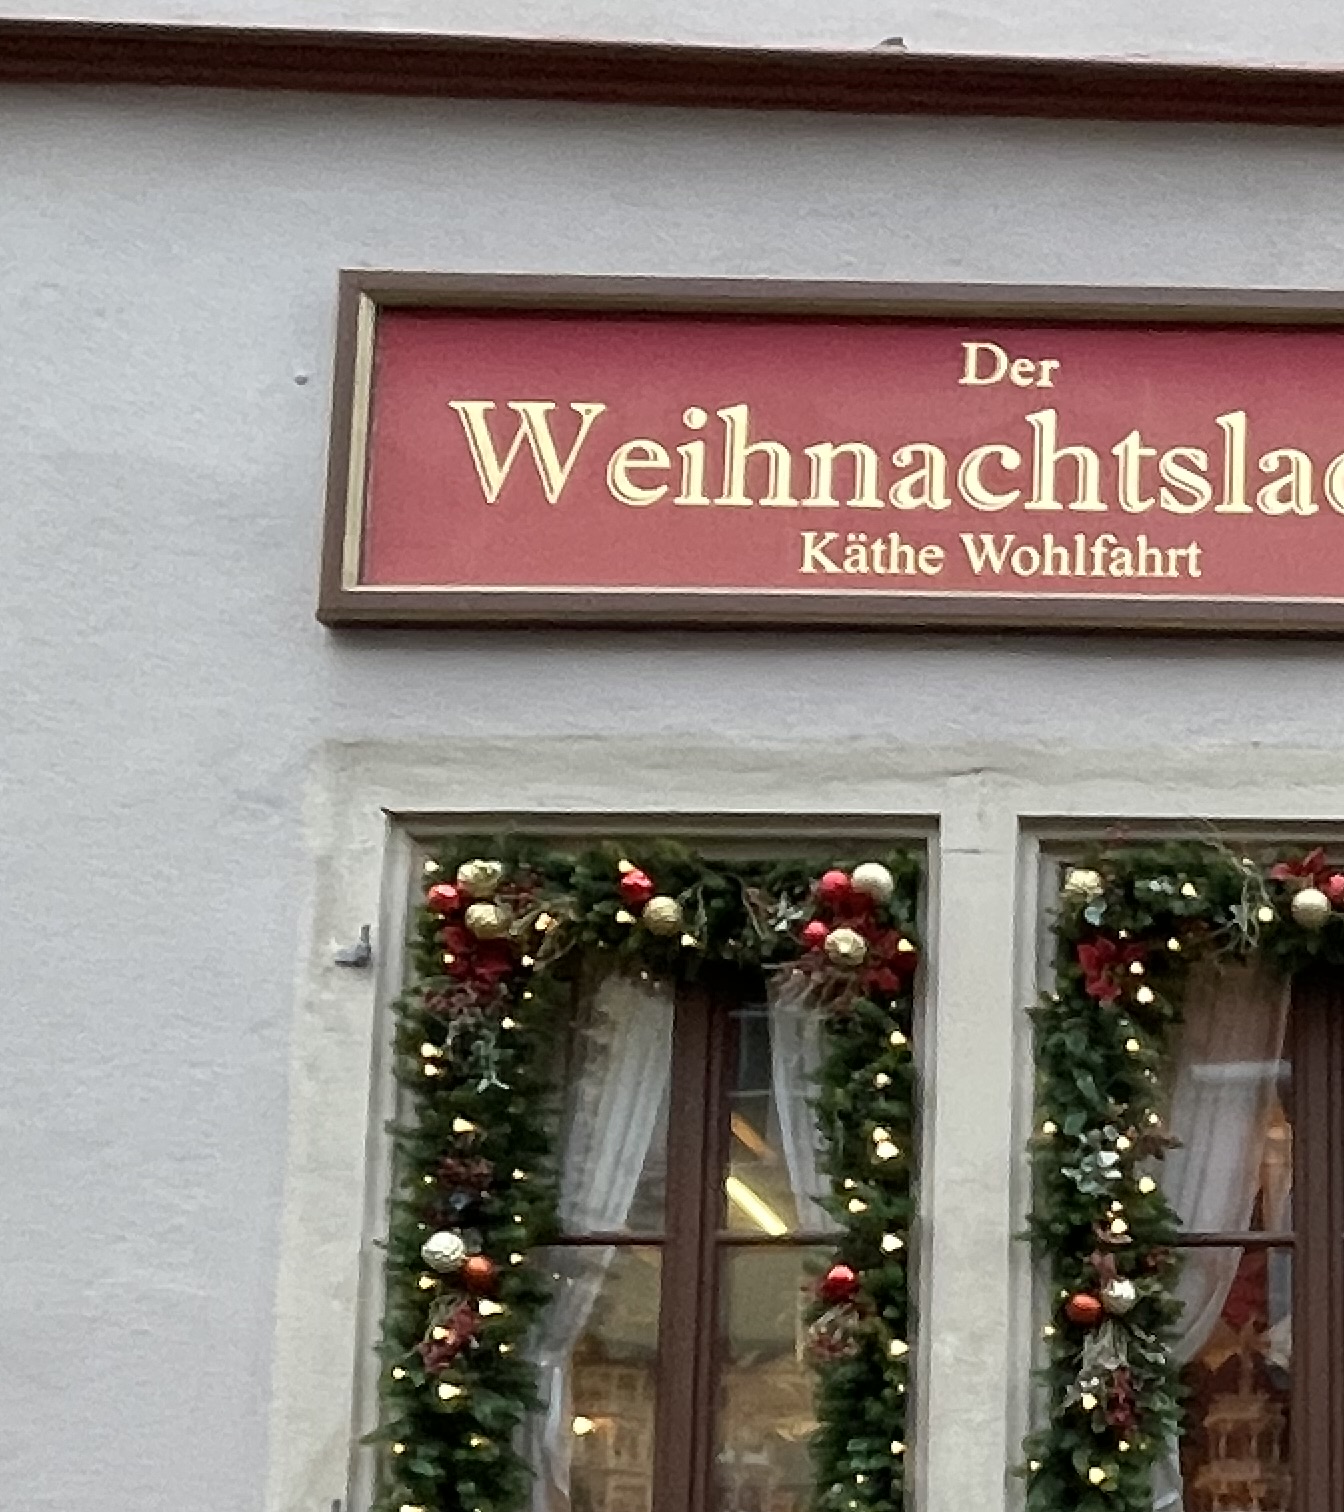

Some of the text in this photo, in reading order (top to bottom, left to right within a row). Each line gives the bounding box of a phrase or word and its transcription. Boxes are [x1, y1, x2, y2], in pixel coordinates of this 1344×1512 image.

[958, 342, 1060, 388] Der
[799, 530, 1204, 578] Käthe Wohlfahrt
